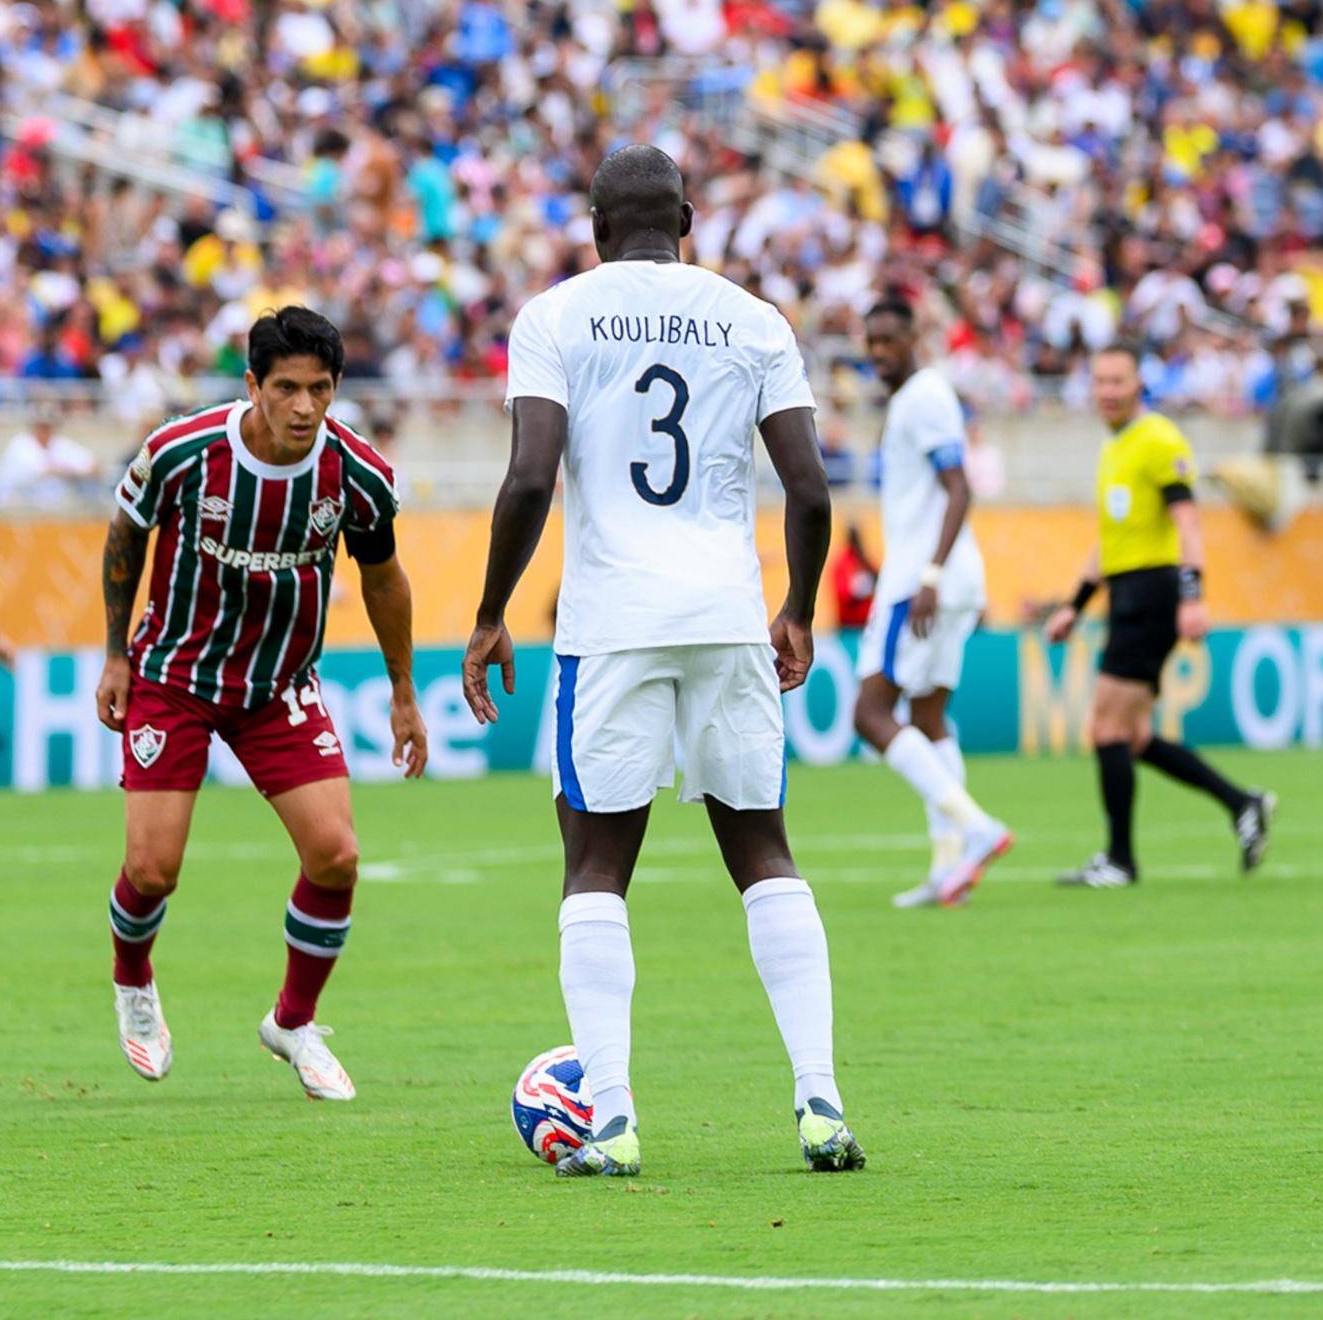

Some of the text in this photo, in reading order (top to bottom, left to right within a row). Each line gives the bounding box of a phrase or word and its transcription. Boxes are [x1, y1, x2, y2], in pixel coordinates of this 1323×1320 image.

[589, 314, 733, 348] KOULIBALY
[630, 363, 690, 507] 3
[199, 535, 328, 572] SUPERBET
[280, 673, 327, 727] 14
[1018, 635, 1211, 758] MP
